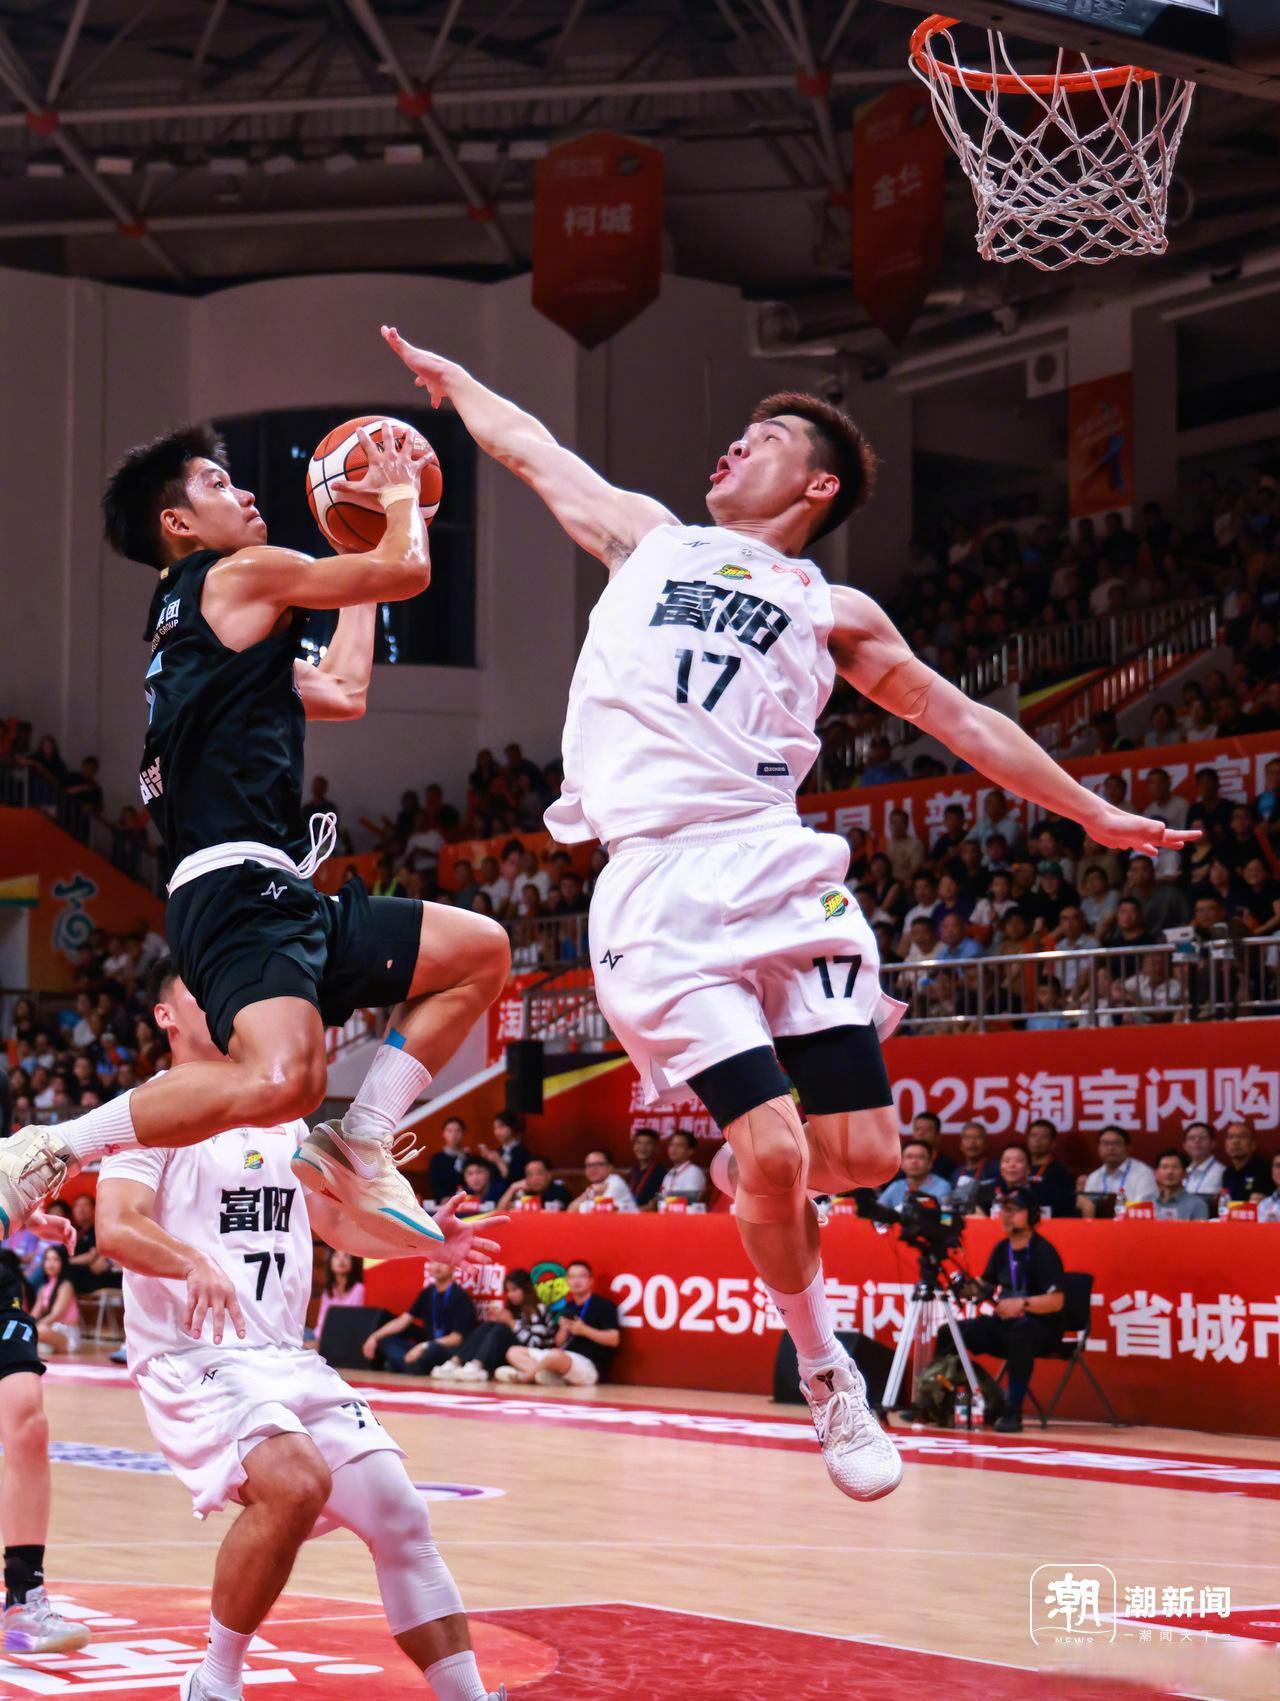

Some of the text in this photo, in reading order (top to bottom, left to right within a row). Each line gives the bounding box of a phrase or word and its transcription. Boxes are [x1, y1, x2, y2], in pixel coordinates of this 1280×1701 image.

[563, 202, 632, 237] 柯城
[649, 579, 792, 656] 富阳
[674, 648, 742, 712] 17
[812, 954, 862, 998] 17
[220, 1187, 297, 1235] 富阳
